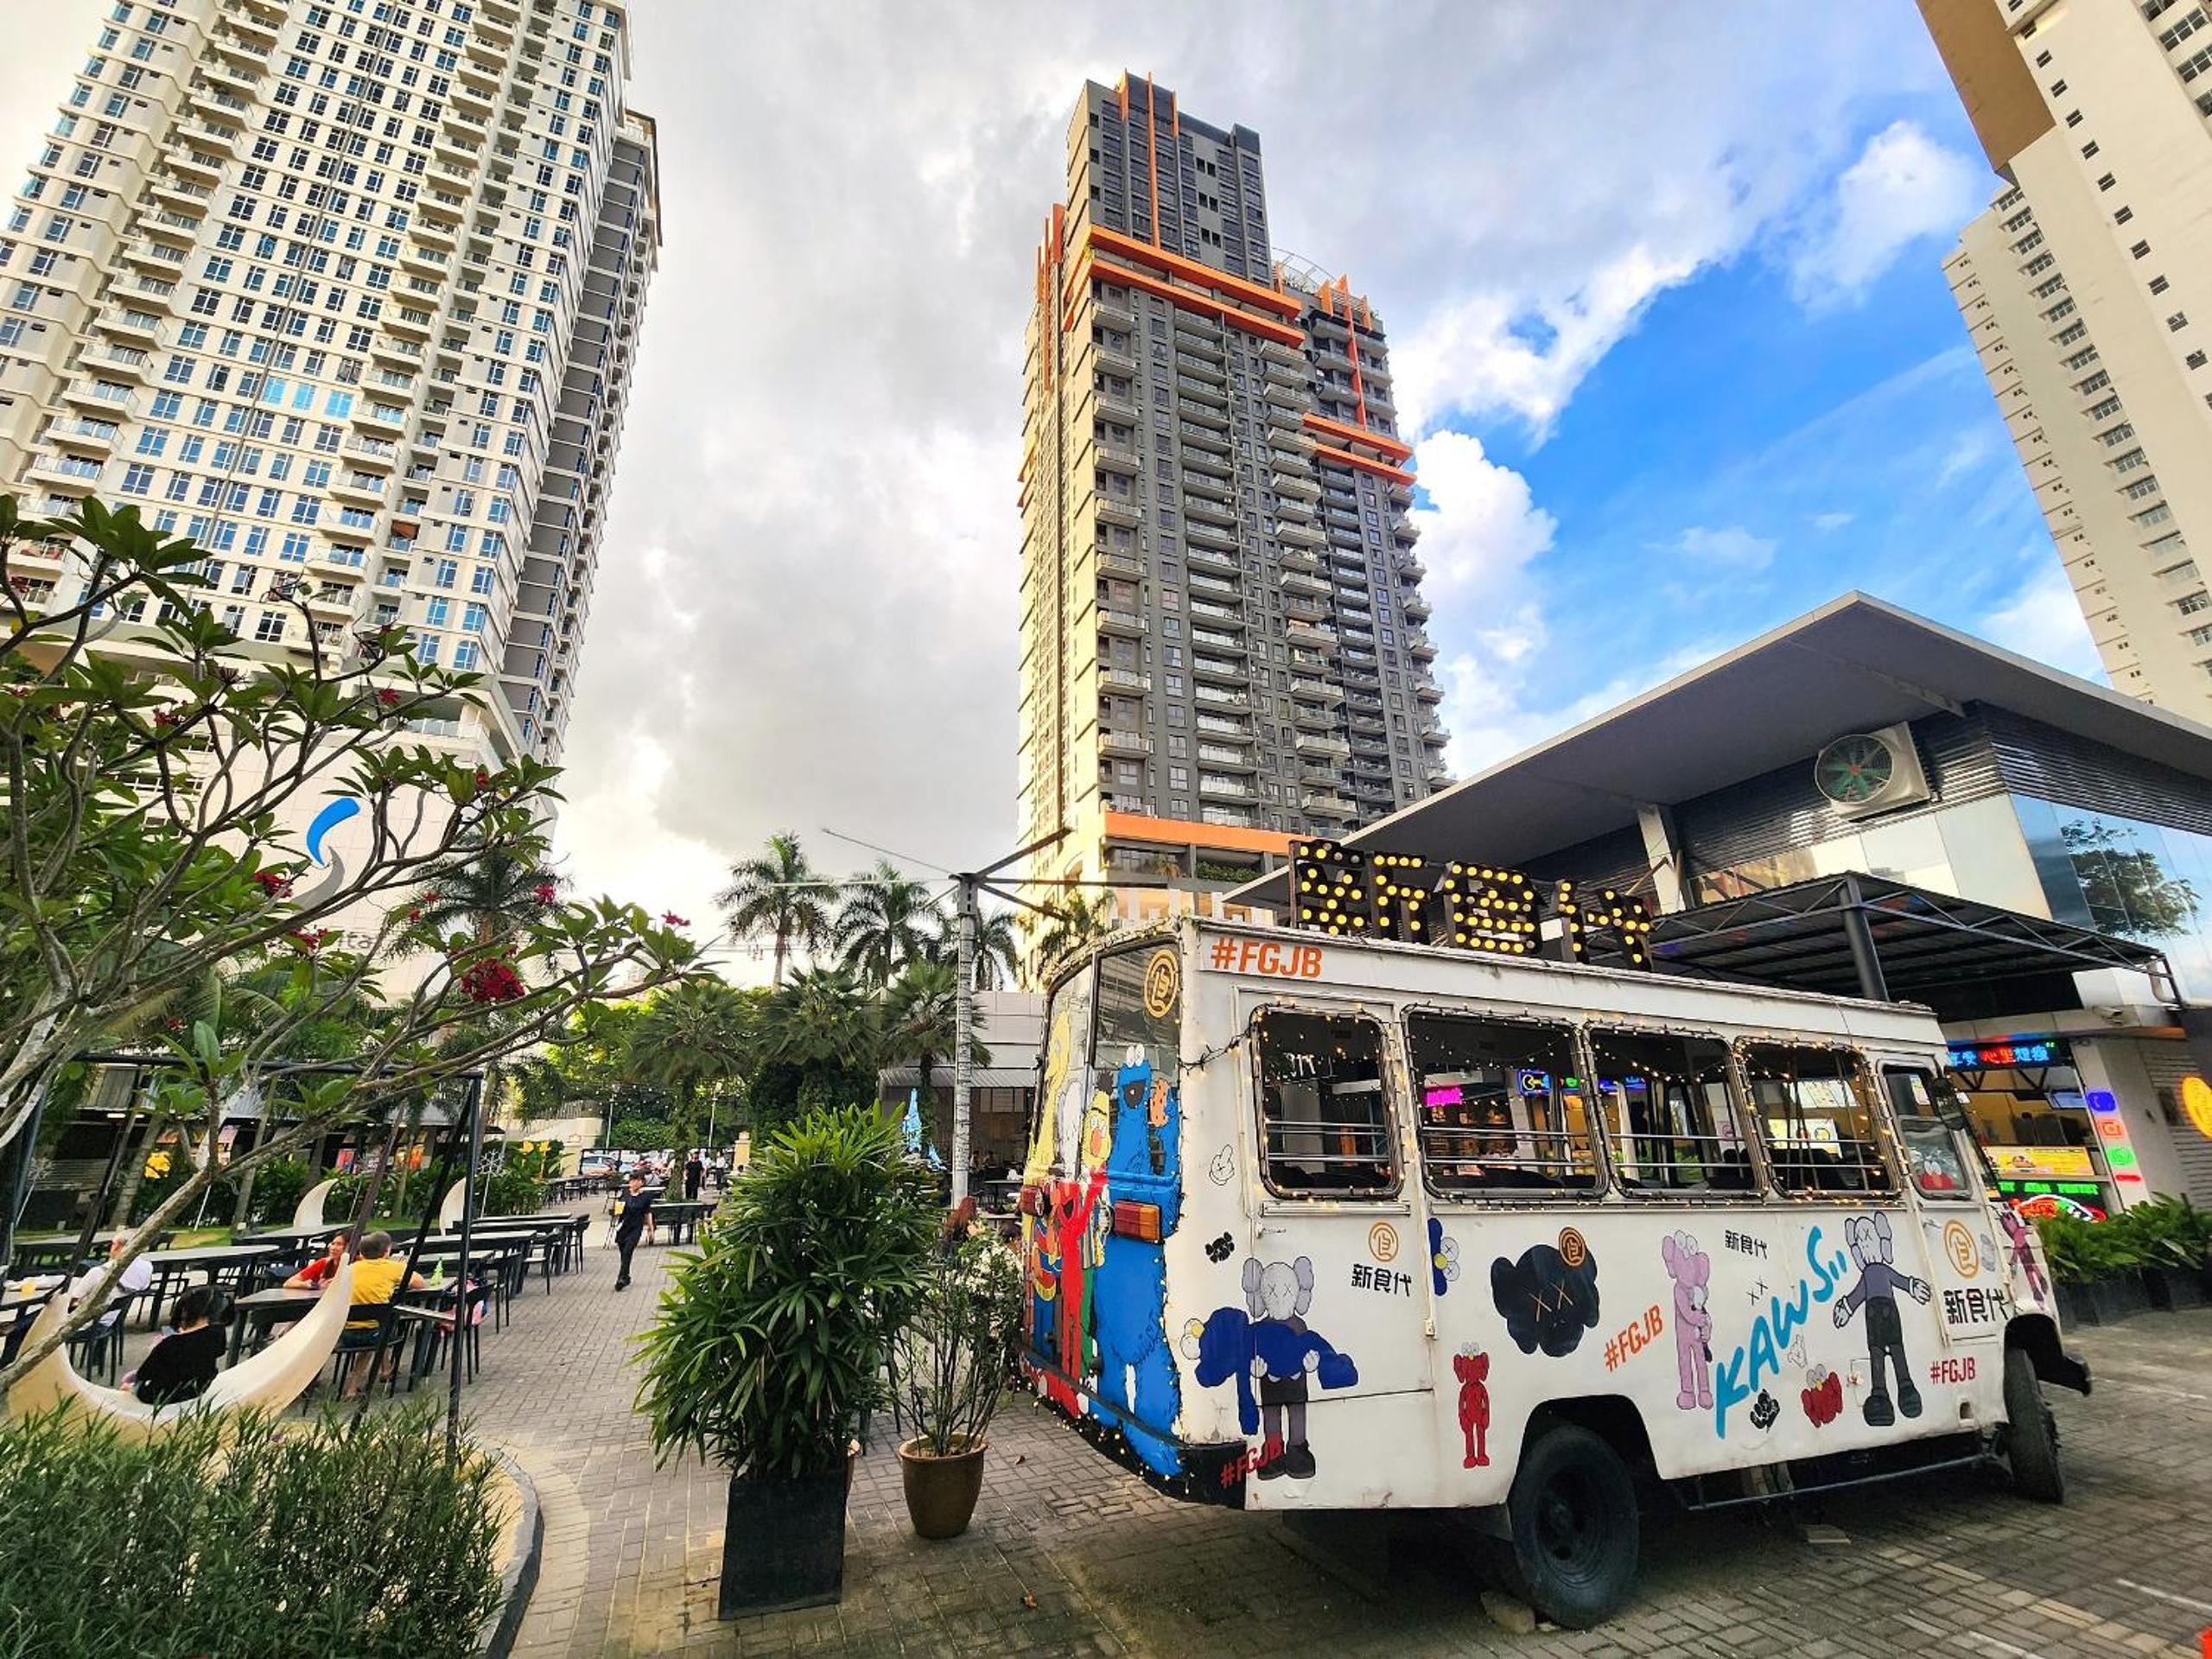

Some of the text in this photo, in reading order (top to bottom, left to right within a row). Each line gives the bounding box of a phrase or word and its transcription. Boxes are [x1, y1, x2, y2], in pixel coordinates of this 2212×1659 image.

[1296, 840, 1655, 972] 新食代
[1211, 937, 1322, 978] #FGJB
[1725, 1230, 1767, 1260] 新食代
[1351, 1263, 1412, 1297] 新食代
[1943, 1288, 2009, 1325] 新食代
[1605, 1305, 1663, 1372] #FGJB
[1930, 1357, 1976, 1384] #FGJB
